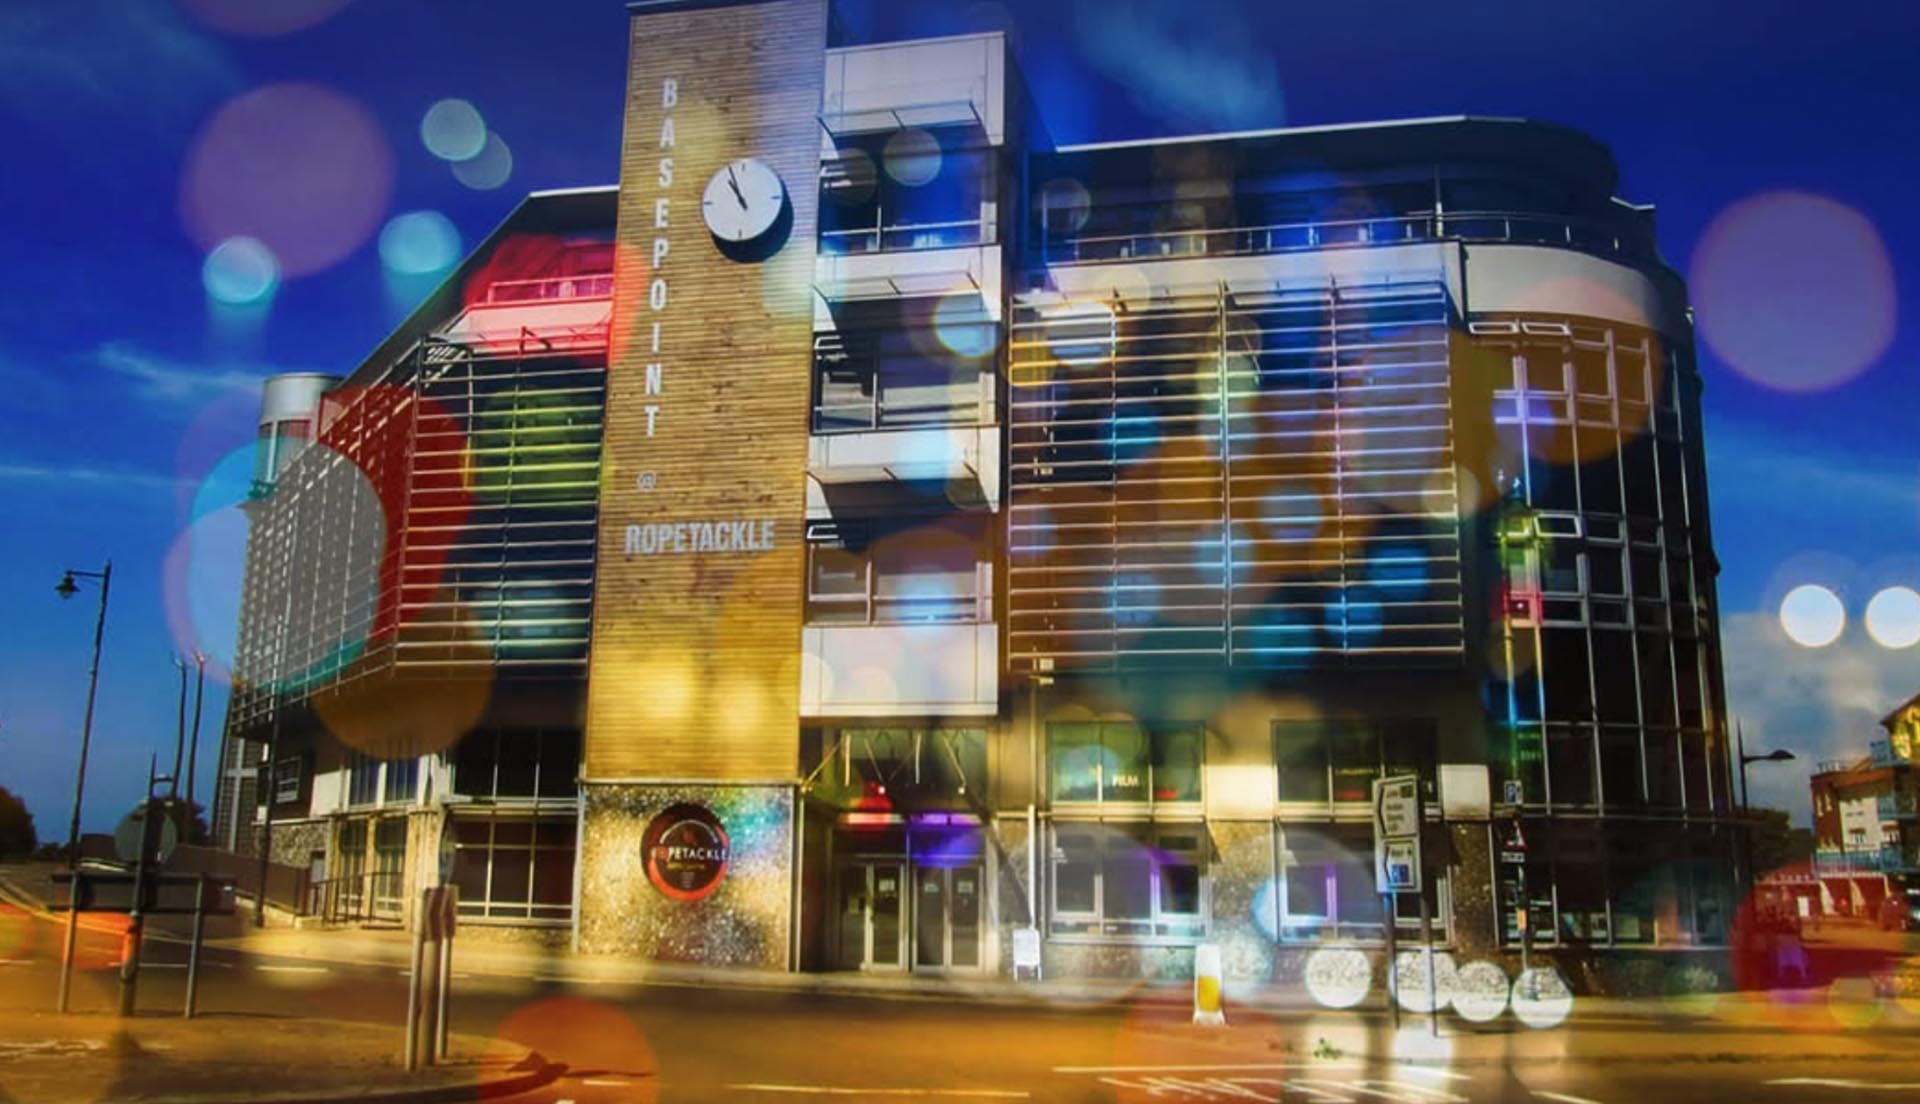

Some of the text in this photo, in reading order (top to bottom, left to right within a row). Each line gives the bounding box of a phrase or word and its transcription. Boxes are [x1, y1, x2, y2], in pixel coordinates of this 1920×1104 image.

[645, 78, 678, 437] BASEPOINT
[637, 471, 657, 492] @
[625, 519, 776, 554] ROPETACKLE
[1112, 775, 1138, 787] FILM
[650, 846, 731, 861] PETACKLE
